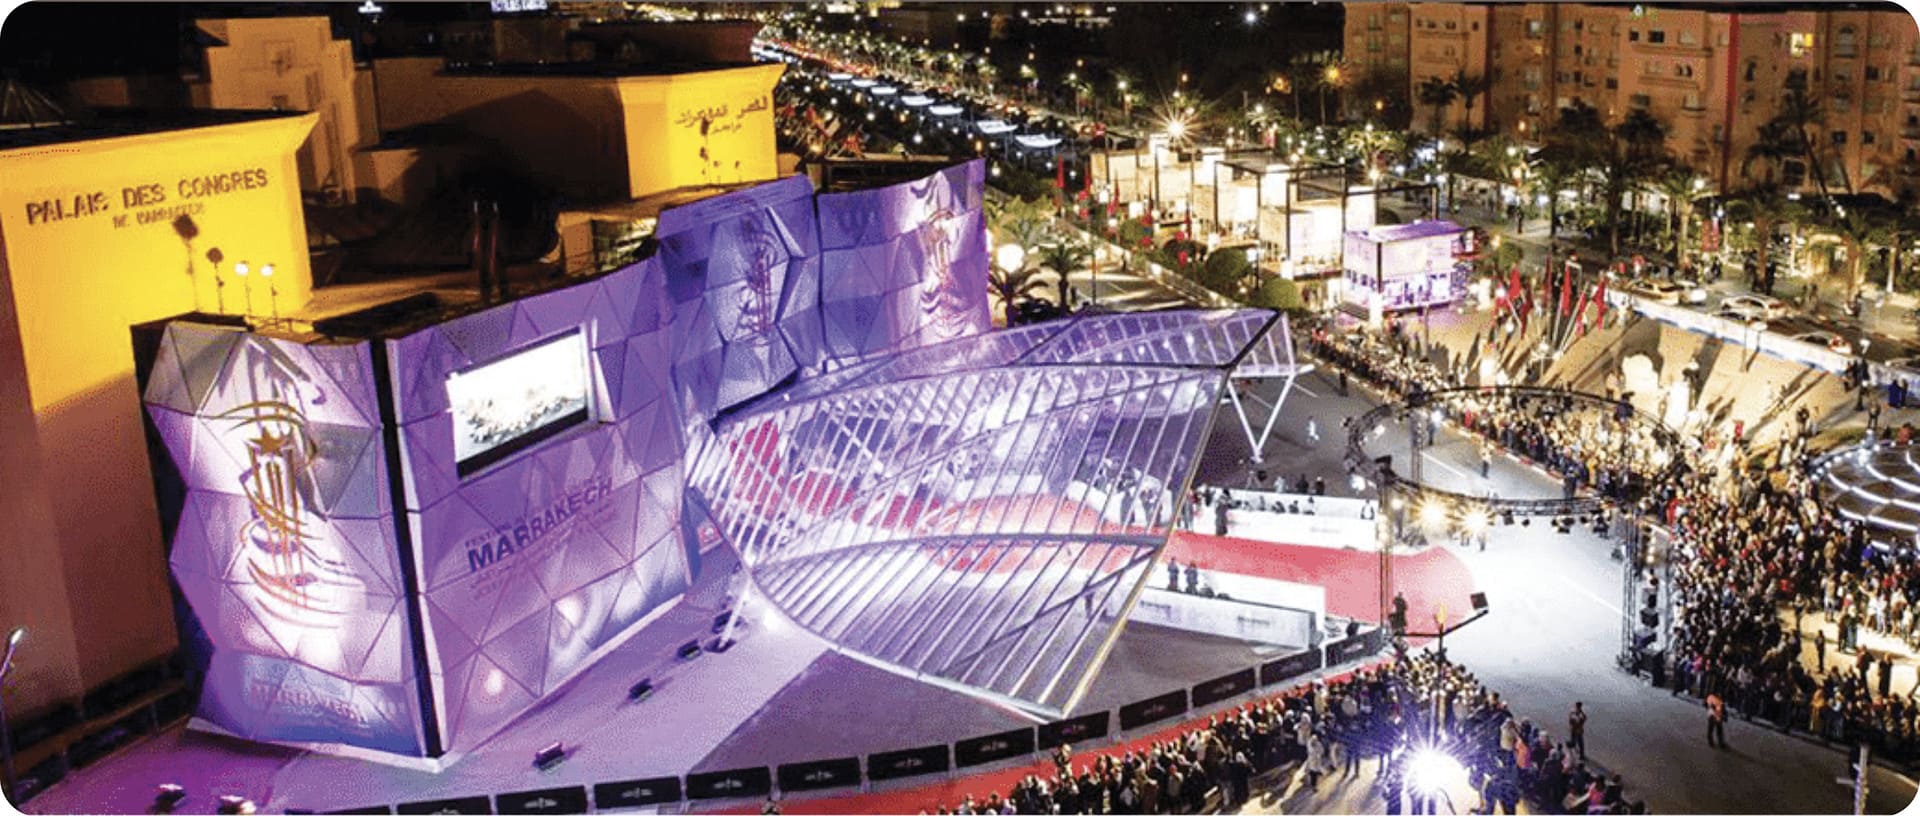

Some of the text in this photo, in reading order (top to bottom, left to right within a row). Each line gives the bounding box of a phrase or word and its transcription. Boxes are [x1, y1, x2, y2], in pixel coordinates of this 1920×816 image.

[25, 191, 109, 226] PALAIS
[122, 183, 166, 209] DES
[468, 477, 613, 573] MARRAKECH
